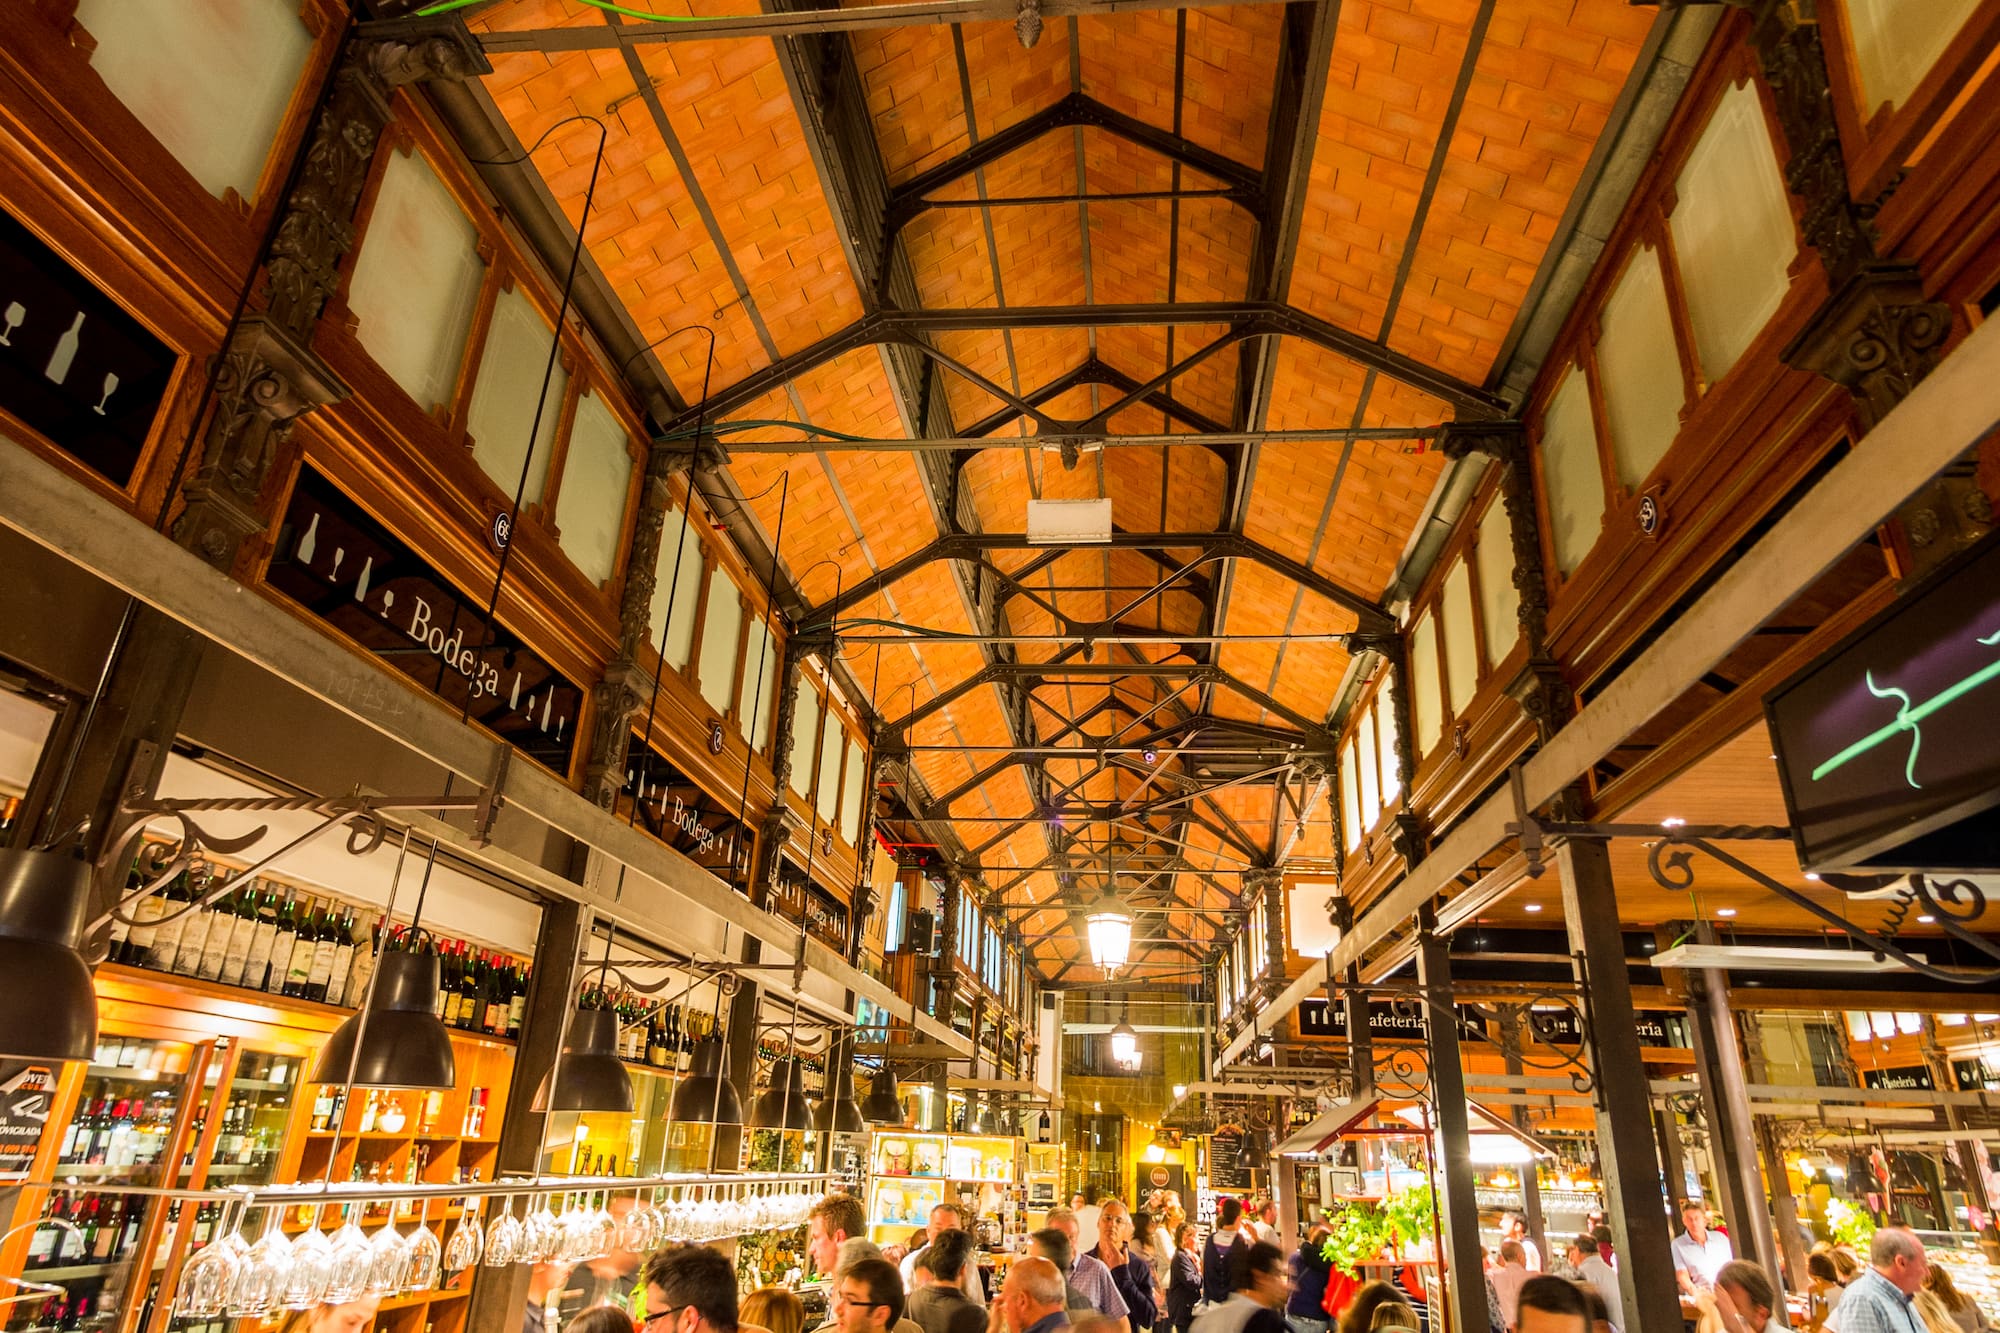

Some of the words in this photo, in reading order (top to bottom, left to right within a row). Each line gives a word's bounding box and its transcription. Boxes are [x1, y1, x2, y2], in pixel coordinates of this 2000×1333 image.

[406, 595, 499, 698] Bodega
[672, 795, 714, 855] Bodega
[1369, 1011, 1426, 1029] afetería
